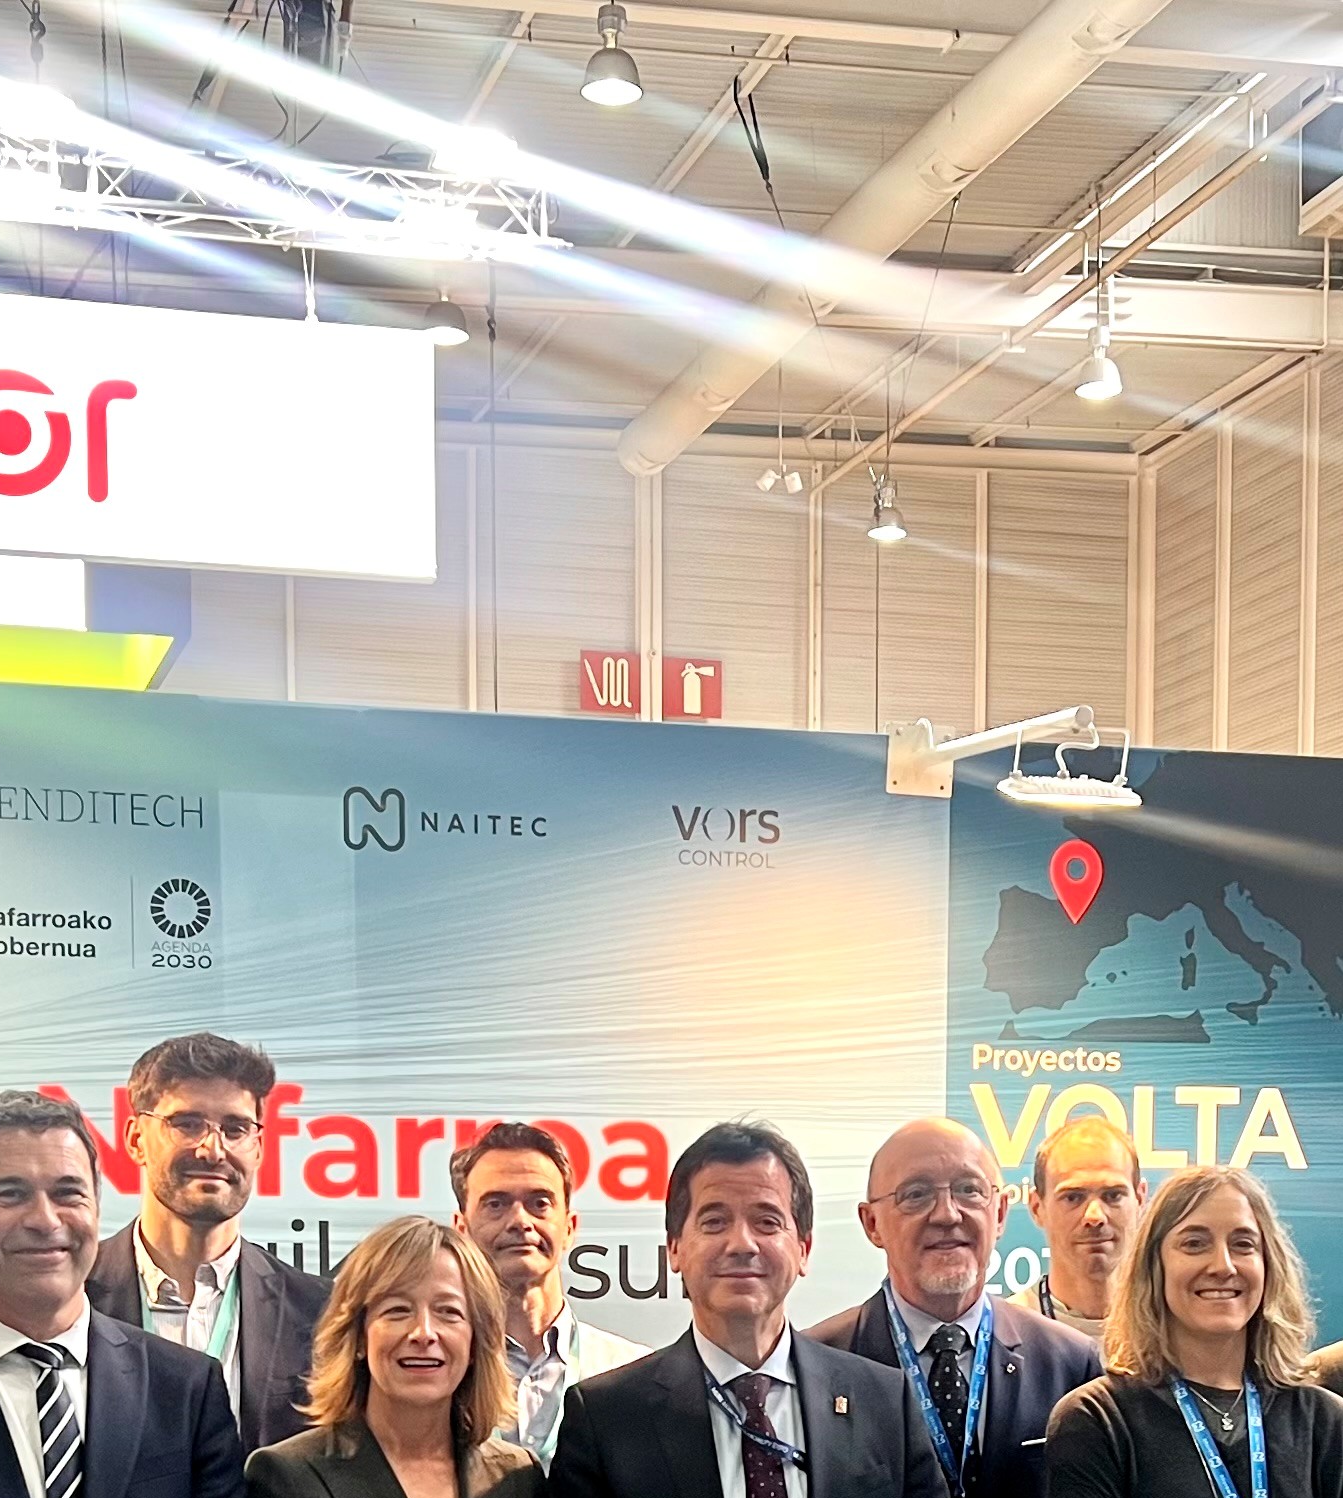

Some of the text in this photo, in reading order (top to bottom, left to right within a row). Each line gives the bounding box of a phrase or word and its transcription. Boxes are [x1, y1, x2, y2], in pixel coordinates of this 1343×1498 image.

[421, 812, 547, 837] NAITEC
[678, 849, 776, 869] CONTROL
[151, 941, 212, 955] AGENDA
[151, 954, 212, 969] 2030
[972, 1043, 1122, 1077] Proyectos
